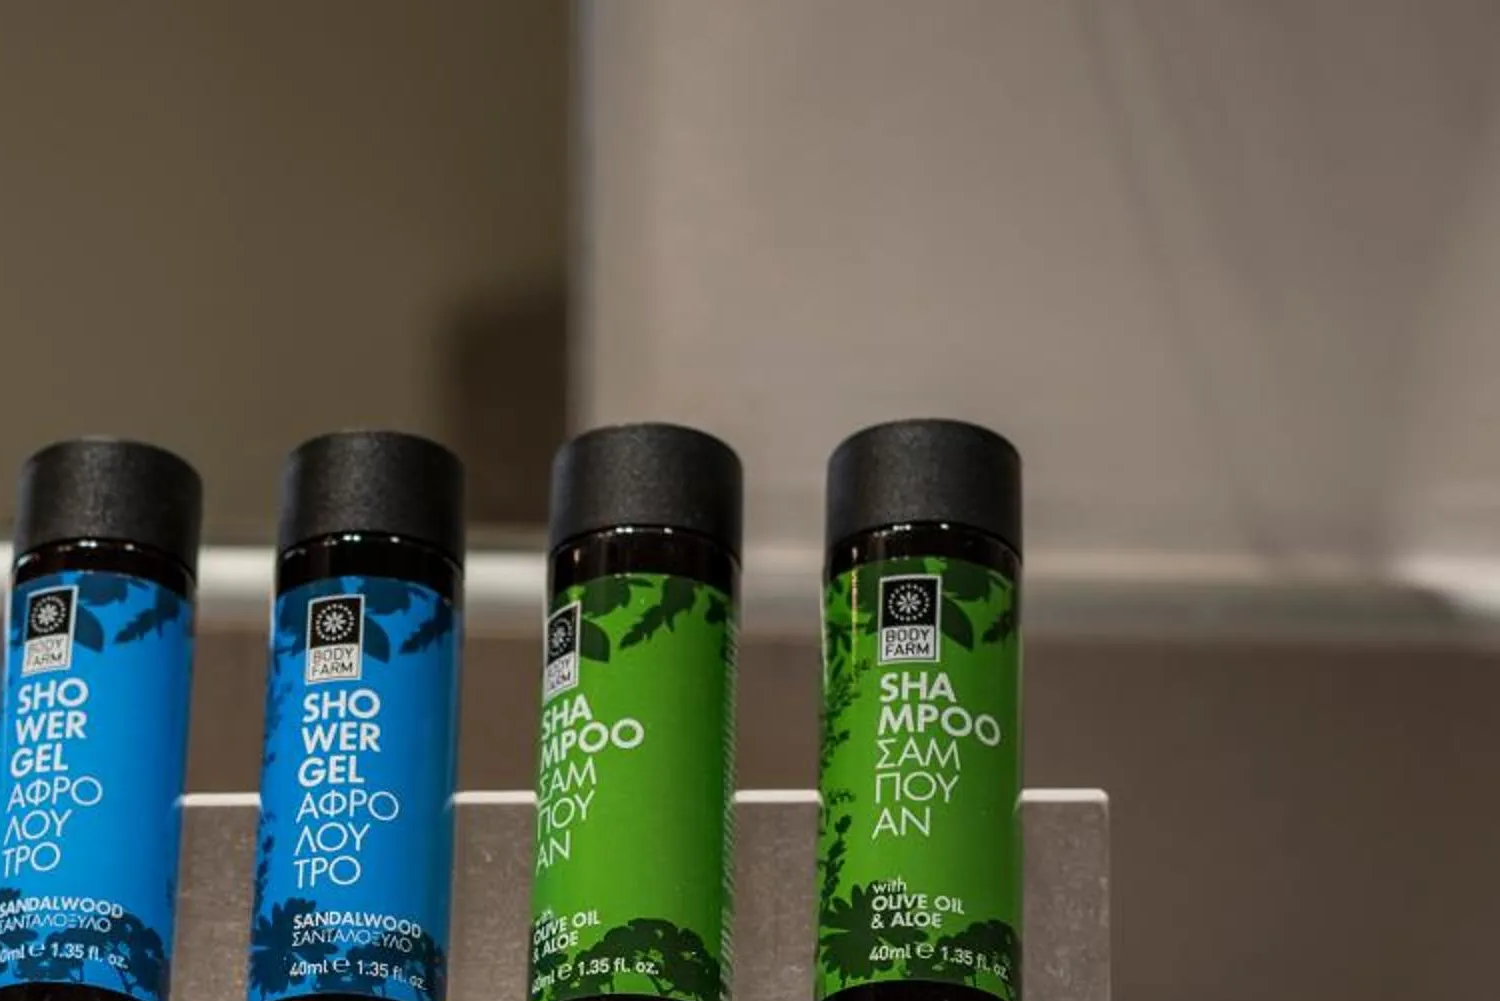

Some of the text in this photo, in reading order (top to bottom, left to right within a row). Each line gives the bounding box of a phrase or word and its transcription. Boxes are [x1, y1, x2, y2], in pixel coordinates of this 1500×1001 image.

[884, 627, 932, 643] BODY
[884, 642, 931, 657] FARM
[311, 661, 353, 677] FARM
[313, 647, 353, 664] BODY
[16, 677, 89, 715] SHO
[879, 671, 957, 703] SHA
[302, 688, 381, 723] SHO
[541, 693, 593, 742] SHA
[14, 710, 87, 745] WER
[301, 721, 381, 755] WER
[877, 702, 1001, 747] MPOO
[10, 743, 69, 778] GEL
[539, 717, 645, 776] MPOO
[875, 736, 961, 771] ΣΑΜ
[297, 754, 365, 788] GEL
[875, 770, 960, 805] ΠΟΥ
[5, 775, 103, 814] ΑΦΡΟ
[295, 789, 400, 824] ΑΦΡΟ
[3, 809, 73, 846] ΛΟΥ
[294, 821, 371, 857] ΛΟΥ
[871, 806, 931, 841] ΑΝ
[2, 841, 61, 879] ΤΡΟ
[292, 855, 361, 889] ΤΡΟ
[872, 876, 907, 895] with
[572, 909, 602, 928] OIL
[870, 911, 943, 930] & ALOE
[871, 893, 965, 915] OLIVE OIL
[293, 911, 421, 939] SANDALWOOD
[51, 942, 86, 961] 1.35
[107, 953, 129, 970] oz.
[541, 931, 579, 958] ALOE
[868, 943, 912, 962] 40ml
[941, 946, 973, 966] 1.35
[289, 959, 329, 977] 40ml
[356, 960, 389, 977] 1.35
[577, 957, 610, 977] 1.35
[612, 958, 631, 973] fl.
[635, 960, 659, 975] oz.
